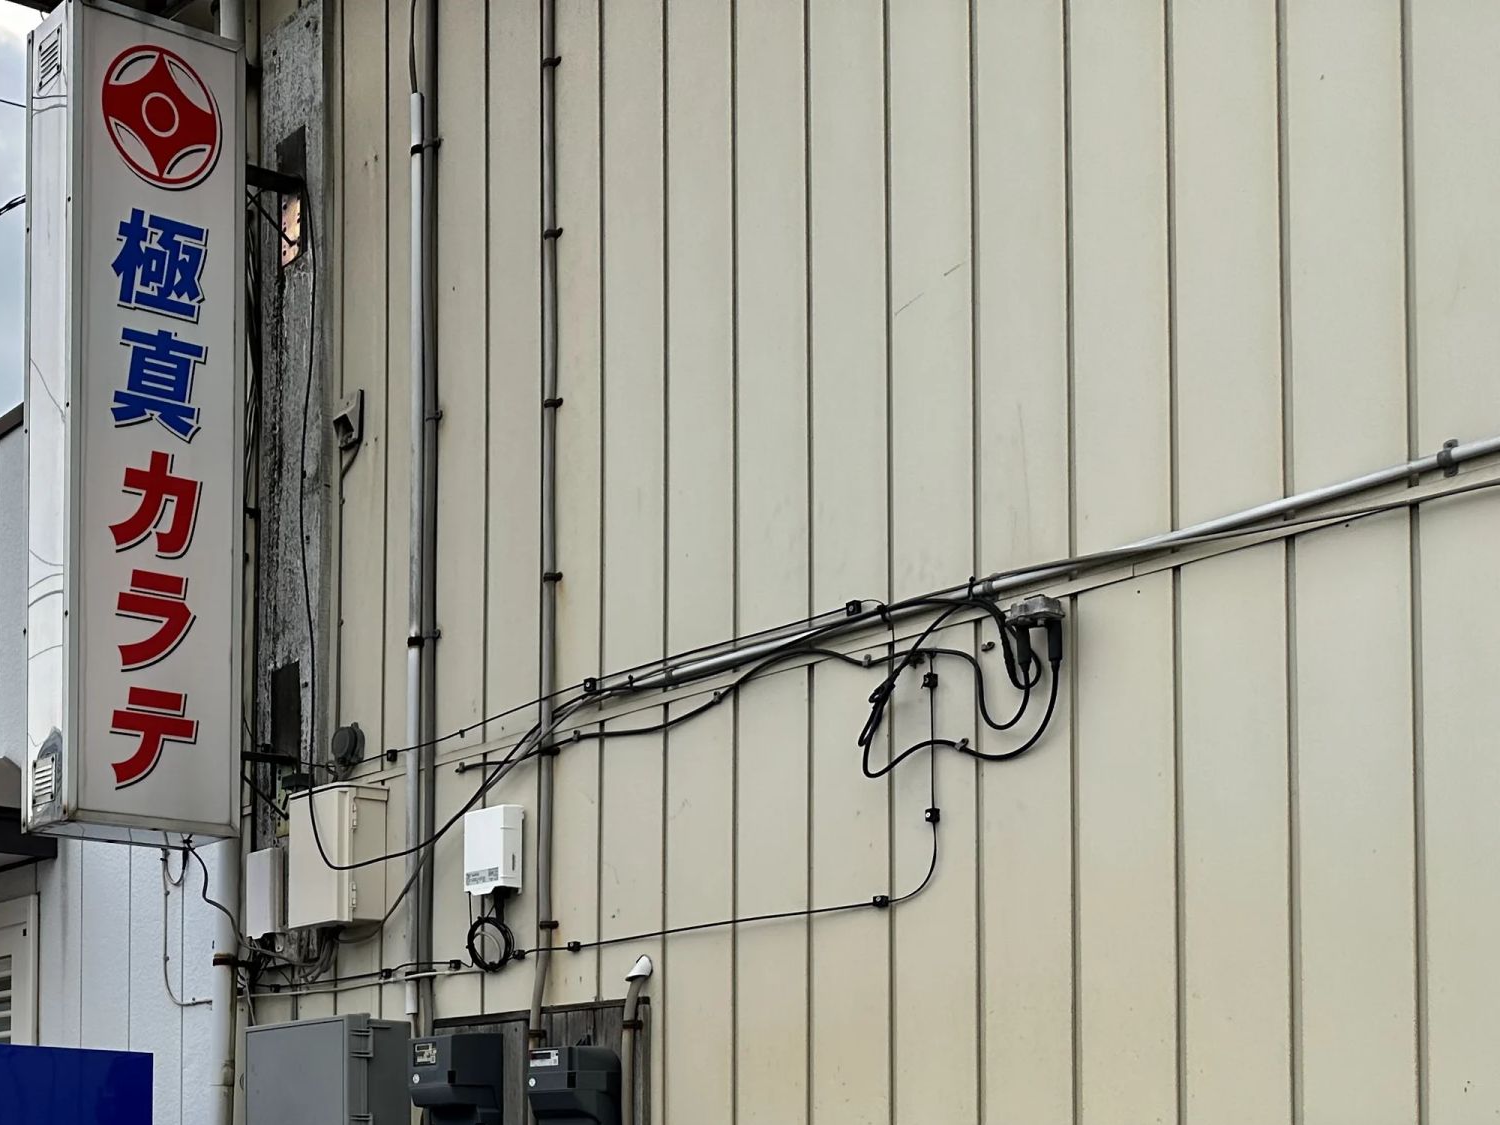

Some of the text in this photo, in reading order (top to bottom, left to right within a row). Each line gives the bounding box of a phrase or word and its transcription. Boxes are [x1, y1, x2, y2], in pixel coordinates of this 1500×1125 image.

[111, 206, 210, 792] 極真カラテ
